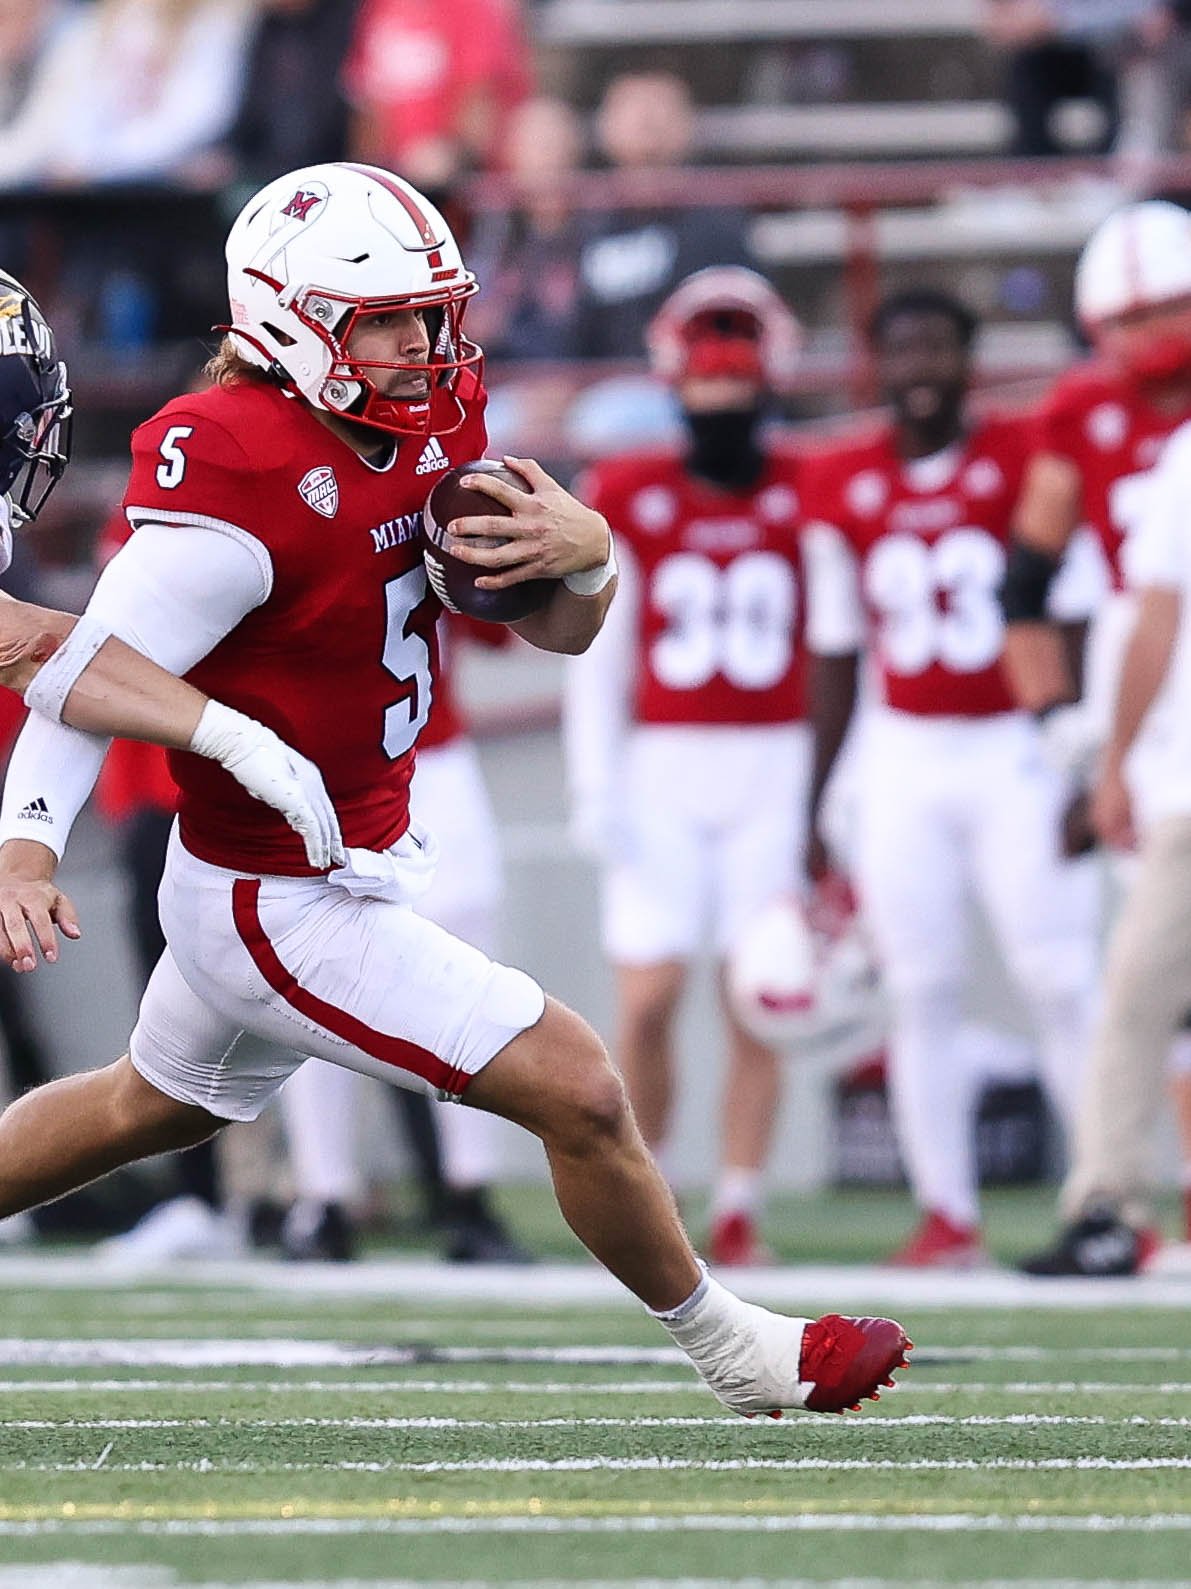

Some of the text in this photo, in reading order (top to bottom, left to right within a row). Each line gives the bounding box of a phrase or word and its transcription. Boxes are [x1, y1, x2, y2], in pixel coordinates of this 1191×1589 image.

[155, 425, 194, 490] 5
[415, 456, 449, 475] adidas
[306, 478, 336, 506] MAC
[369, 511, 423, 553] MIAM
[649, 548, 800, 692] 30
[381, 560, 434, 760] 5
[17, 810, 54, 825] adidas
